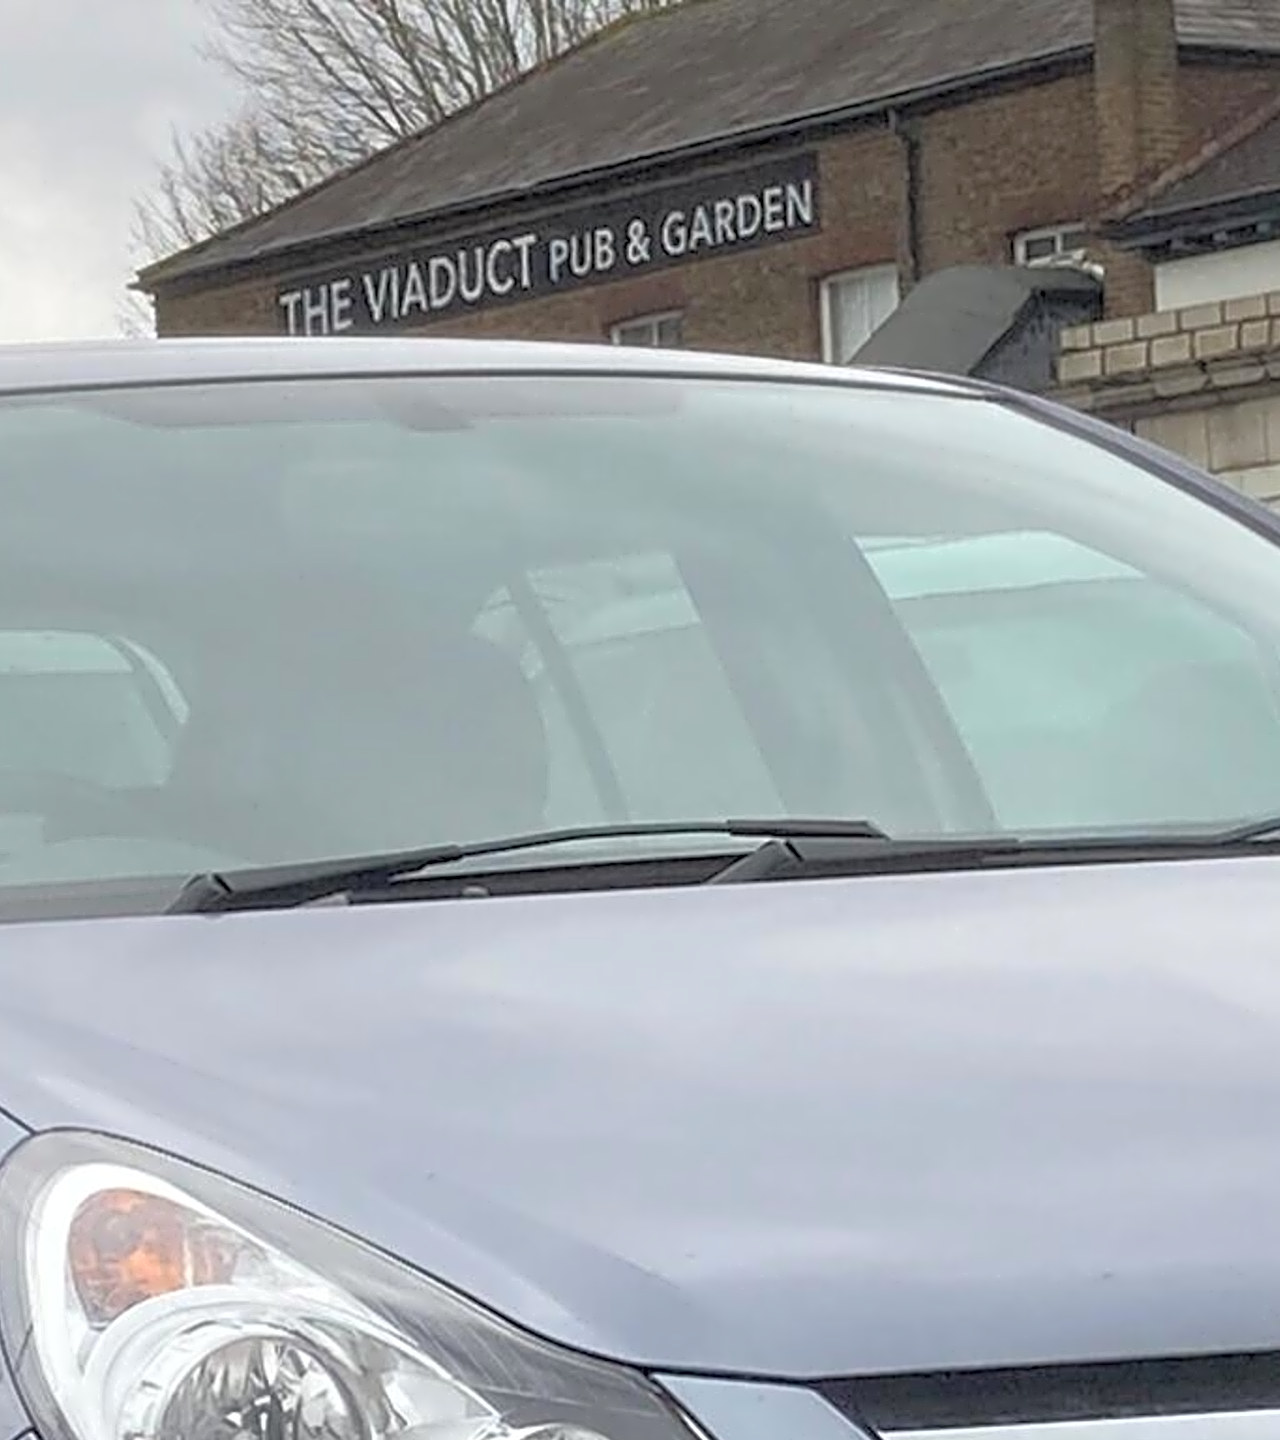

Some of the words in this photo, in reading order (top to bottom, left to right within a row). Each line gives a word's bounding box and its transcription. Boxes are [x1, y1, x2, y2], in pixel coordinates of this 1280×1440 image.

[279, 280, 353, 336] THE
[362, 233, 537, 323] VIADUCT
[548, 228, 616, 283] PUB
[626, 218, 652, 264] &
[661, 179, 813, 256] GARDEN
